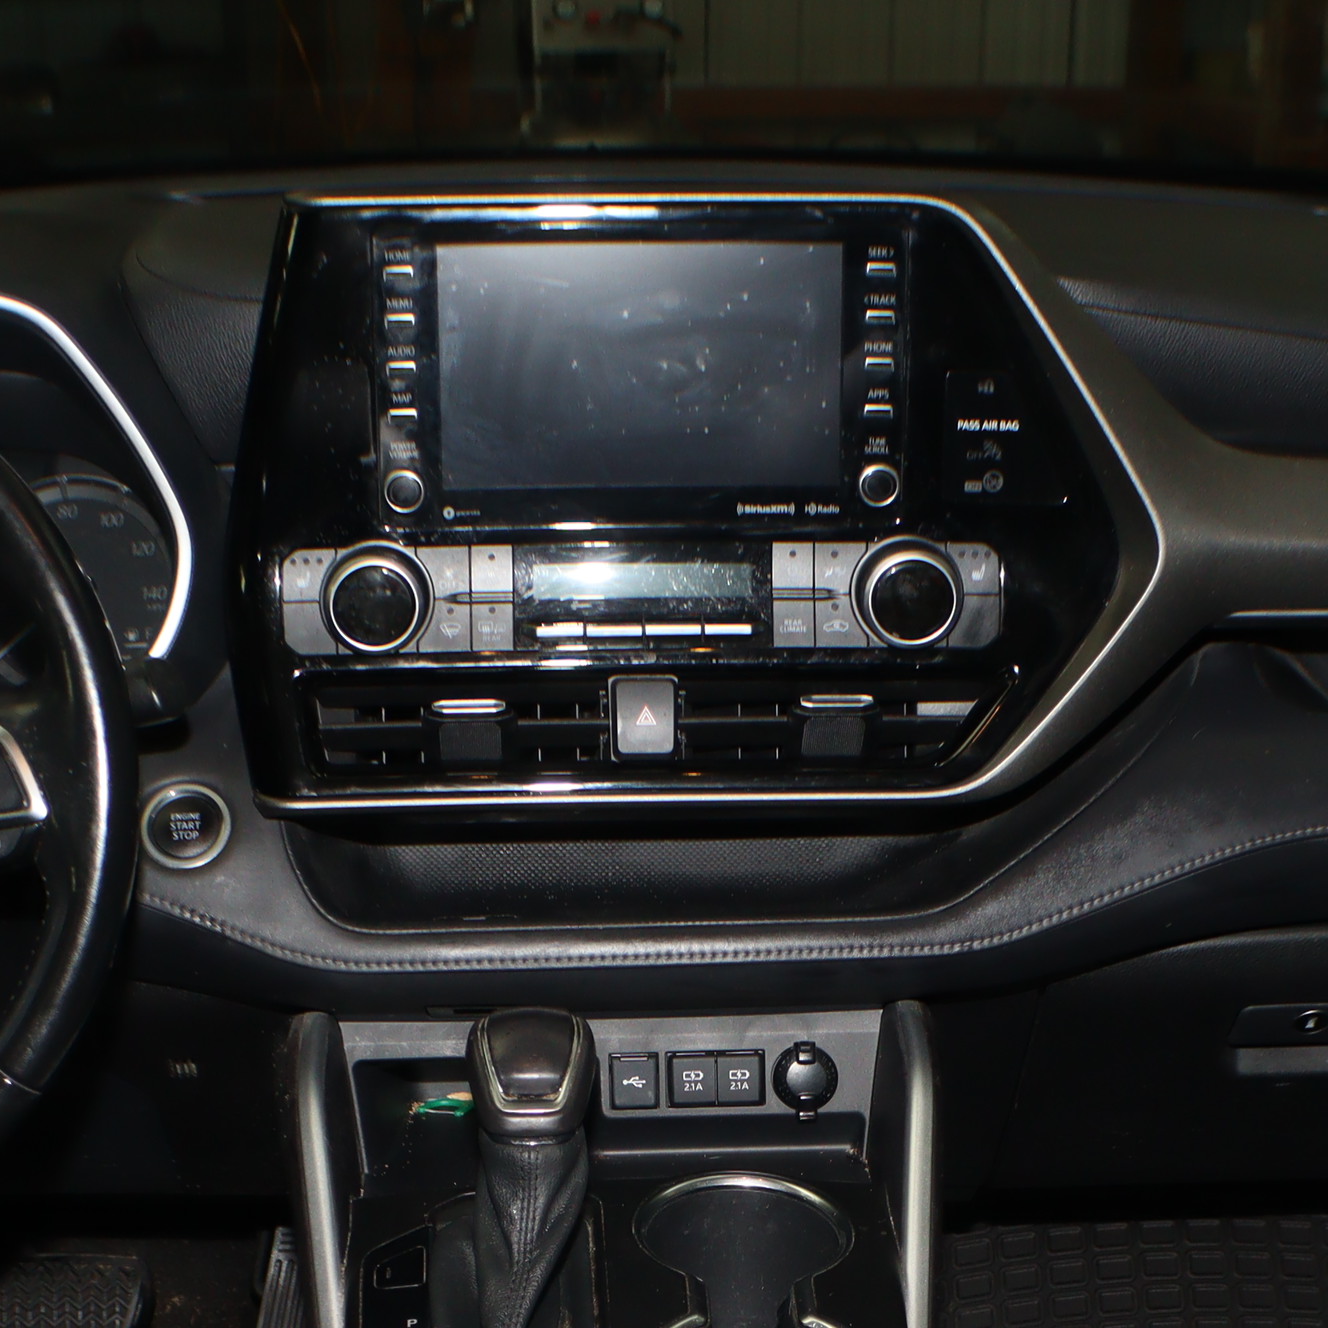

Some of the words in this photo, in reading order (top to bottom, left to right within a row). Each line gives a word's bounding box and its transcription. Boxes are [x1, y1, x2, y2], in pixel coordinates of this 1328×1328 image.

[385, 297, 413, 309] MENU
[387, 345, 416, 357] AUDIO
[864, 341, 893, 353] PHONE
[391, 392, 412, 404] MAP
[867, 388, 890, 400] APPS
[957, 419, 980, 431] PASS
[981, 419, 998, 431] AIR
[999, 419, 1020, 432] BAG
[57, 504, 79, 520] 80
[817, 503, 840, 515] Radio
[100, 513, 125, 529] 100
[131, 541, 156, 558] 120
[142, 586, 168, 602] 140
[783, 618, 803, 627] REAR
[779, 626, 807, 635] CLIMATE
[170, 812, 201, 821] ENGINE
[170, 821, 202, 831] START
[172, 830, 200, 841] STOP
[683, 1082, 704, 1092] 2.1A
[729, 1081, 750, 1091] 2.1A
[406, 1318, 418, 1328] P
